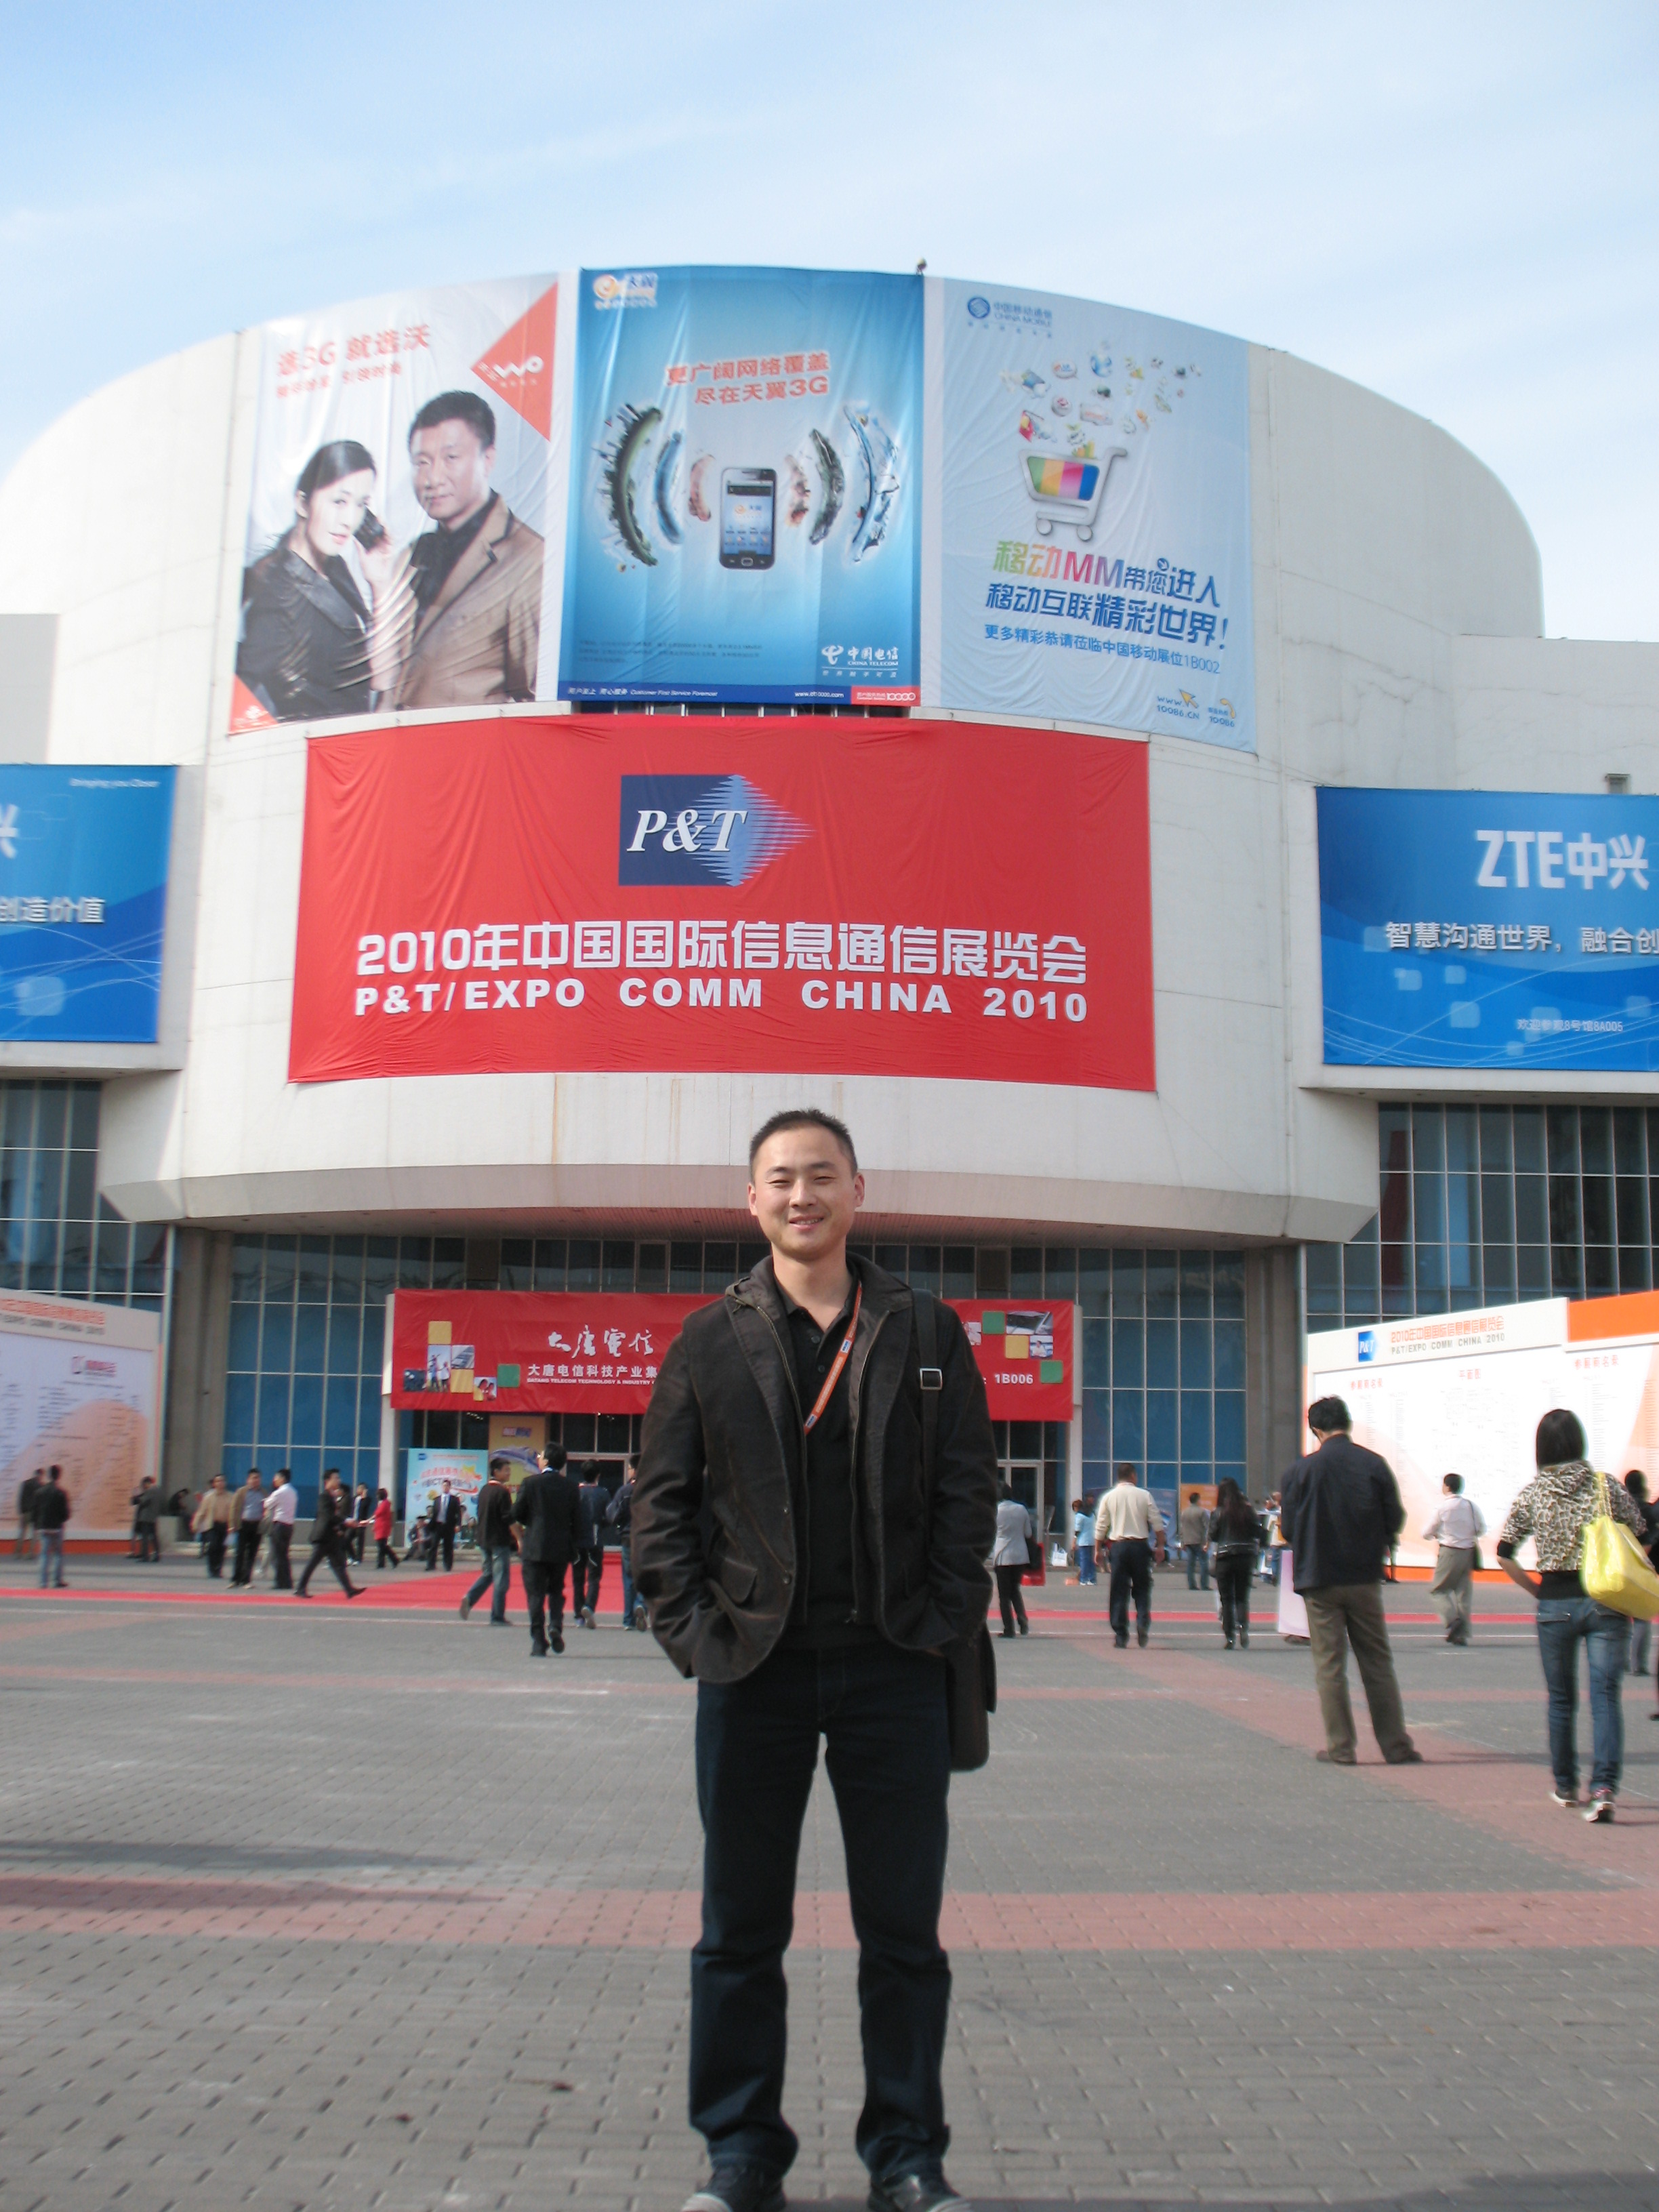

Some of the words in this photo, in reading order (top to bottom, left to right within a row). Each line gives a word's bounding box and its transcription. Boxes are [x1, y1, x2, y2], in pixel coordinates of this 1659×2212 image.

[665, 351, 830, 386] 更广阔网络覆盖
[695, 375, 830, 406] 尽在天翼3G
[847, 646, 899, 661] 中国电信
[886, 692, 916, 701] 10000
[1157, 705, 1200, 720] 10086.CN
[1209, 716, 1235, 728] 10086
[626, 808, 747, 853] P&T
[1476, 829, 1650, 890] ZTE中兴
[356, 920, 1087, 985] 2010年中国国际信息通信展览会
[356, 978, 586, 1017] P&T/EXPO
[618, 979, 763, 1009] COMM
[801, 979, 953, 1014] CHINA
[983, 987, 1088, 1023] 2010
[1391, 1315, 1504, 1343] 2010年中国国际信息通信展览会
[1359, 1340, 1375, 1354] P&T
[1391, 1341, 1427, 1355] P&T/EXPO
[1431, 1339, 1453, 1350] COMM
[1458, 1336, 1482, 1347] CHINA
[1486, 1332, 1505, 1344] 2010
[994, 1373, 1033, 1385] 1B006
